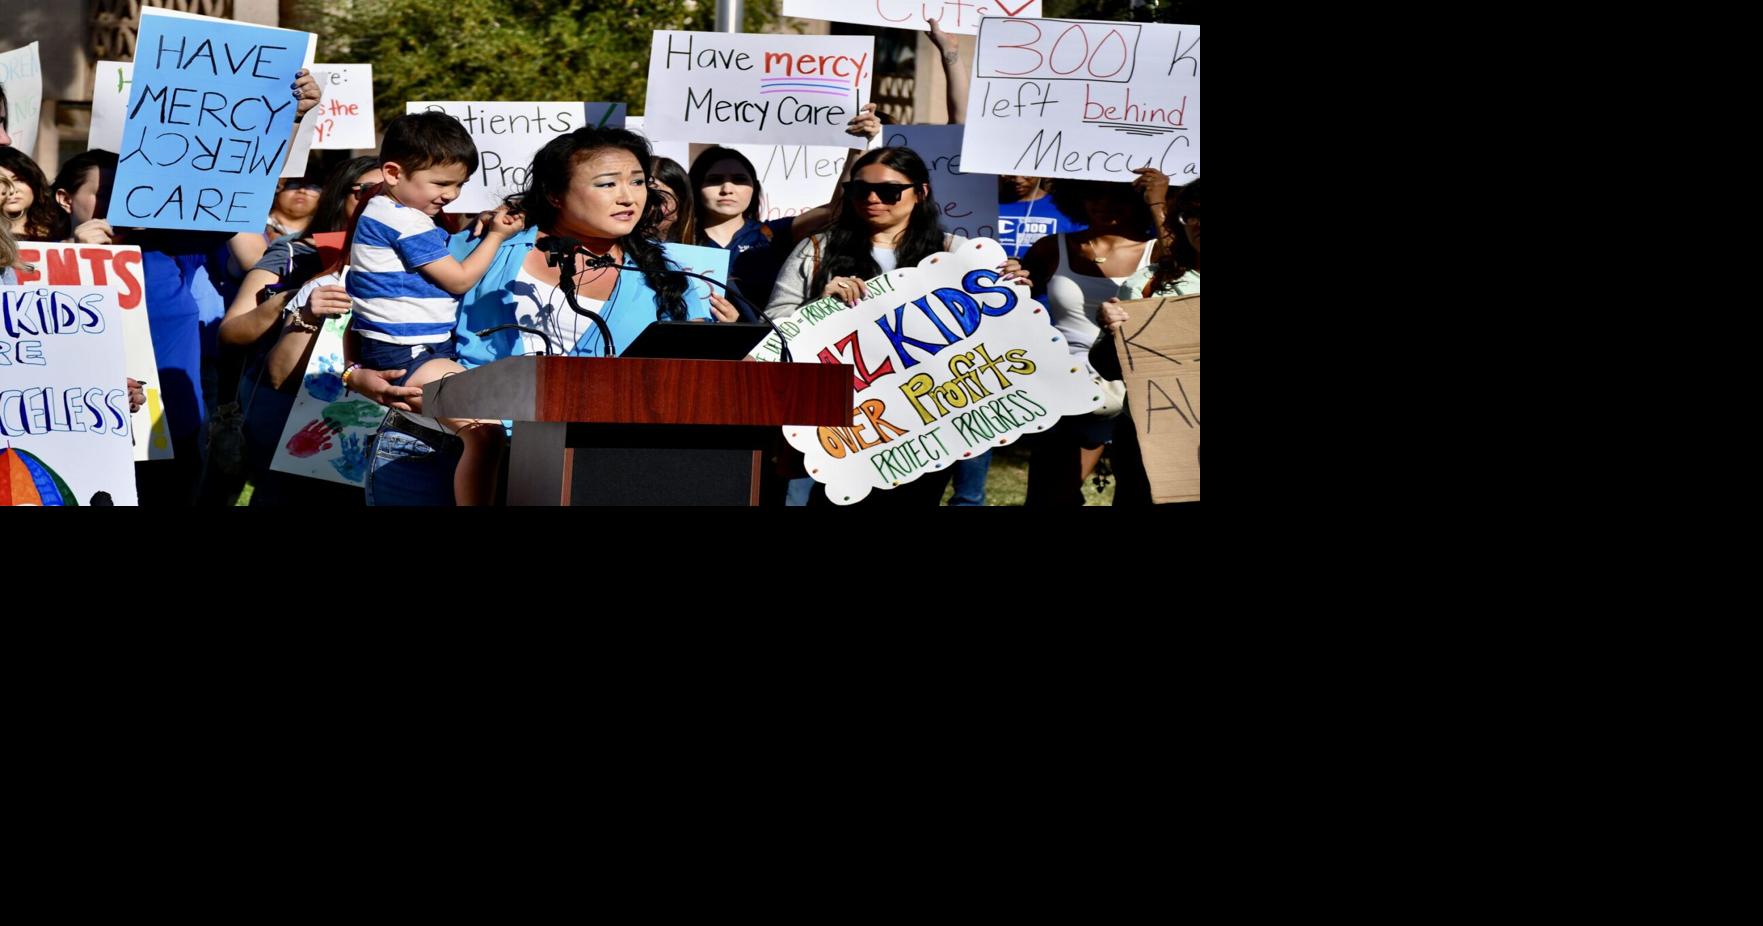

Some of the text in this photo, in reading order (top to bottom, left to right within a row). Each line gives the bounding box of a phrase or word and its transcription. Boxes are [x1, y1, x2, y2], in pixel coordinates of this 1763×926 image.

[156, 34, 287, 80] HAVE
[666, 34, 868, 87] Have mercy,
[995, 20, 1127, 78] 300
[130, 84, 291, 134] MERCY
[328, 98, 359, 116] the
[684, 87, 769, 131] Mercy
[982, 82, 1187, 126] left behind
[126, 185, 254, 223] CARE
[875, 269, 1018, 369] KIDS
[817, 343, 1036, 459] OVER Profits
[870, 390, 1047, 483] PROTECT PROGRESS
